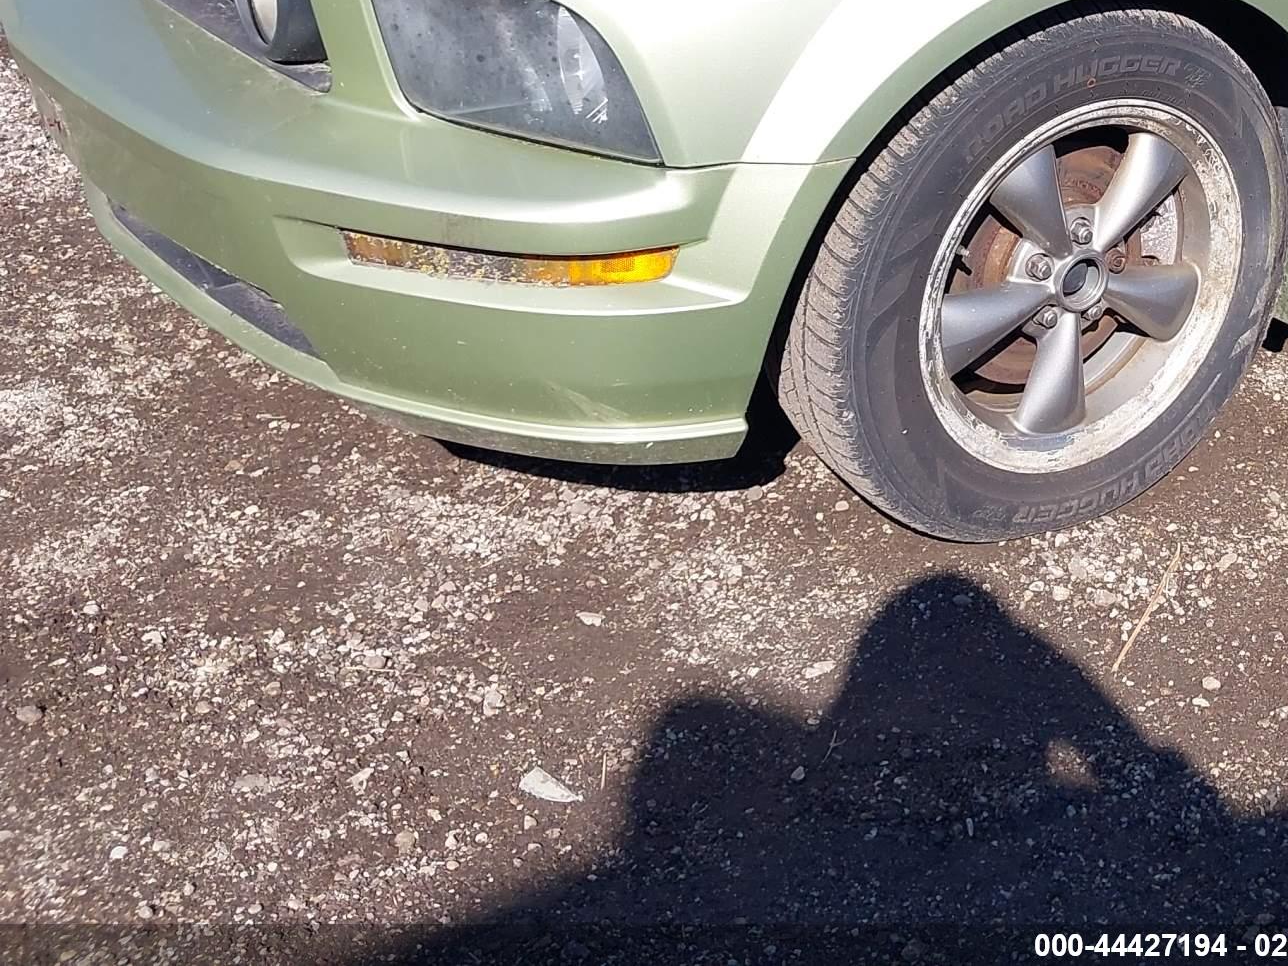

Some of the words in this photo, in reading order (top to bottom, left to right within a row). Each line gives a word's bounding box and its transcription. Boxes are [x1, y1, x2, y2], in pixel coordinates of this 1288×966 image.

[967, 81, 1047, 164] ROAD
[1054, 54, 1181, 93] HUGGER
[1013, 472, 1139, 523] HUGGER
